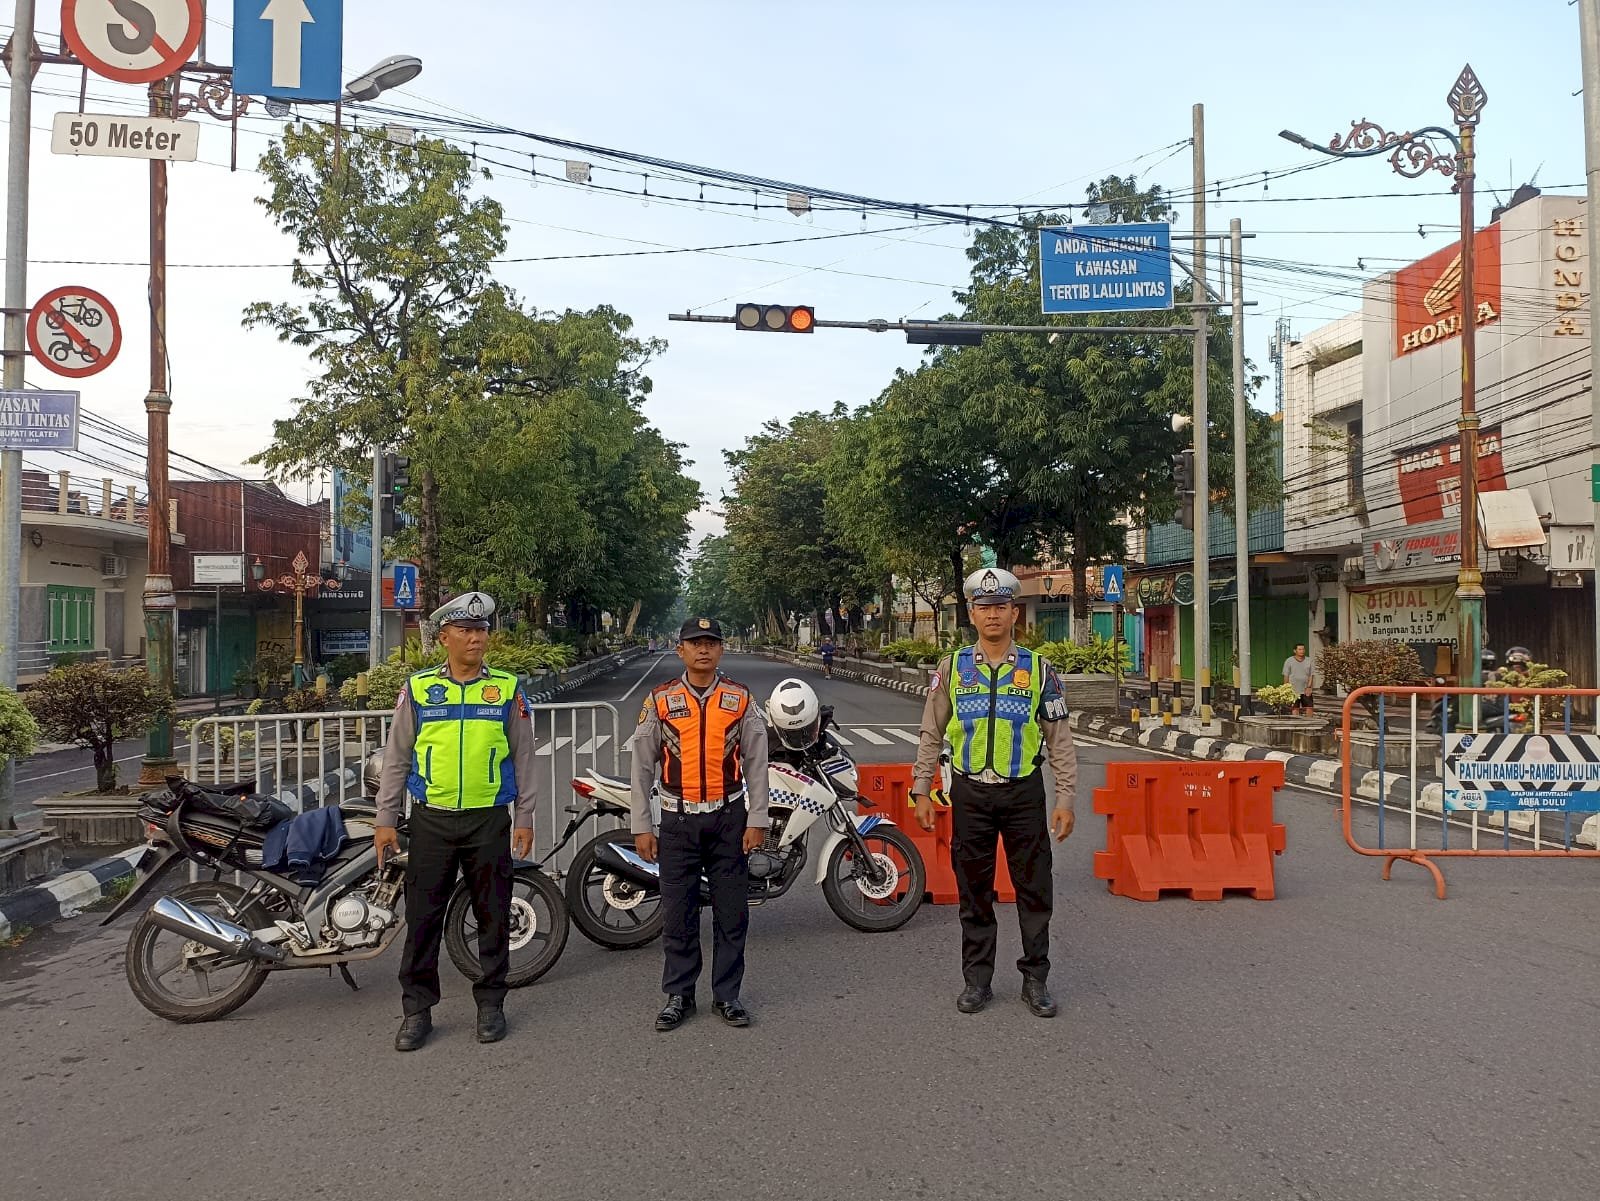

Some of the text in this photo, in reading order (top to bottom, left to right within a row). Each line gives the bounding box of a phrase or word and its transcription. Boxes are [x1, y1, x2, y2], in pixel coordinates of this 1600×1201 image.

[69, 121, 181, 151] 50 Meter
[1054, 235, 1157, 255] ANDA MEMASUKI
[1075, 259, 1137, 277] KAWASAN
[1553, 217, 1584, 337] HONDA
[1049, 281, 1166, 300] TERTIB LALU LINTAS
[1402, 301, 1499, 352] HONA
[0, 397, 41, 413] ASAN
[27, 413, 70, 428] LINTAS
[28, 430, 59, 438] KLATEN
[1459, 762, 1600, 780] PATUHI RAMBU-RAMBU LALU LIN
[1542, 798, 1566, 806] DULU
